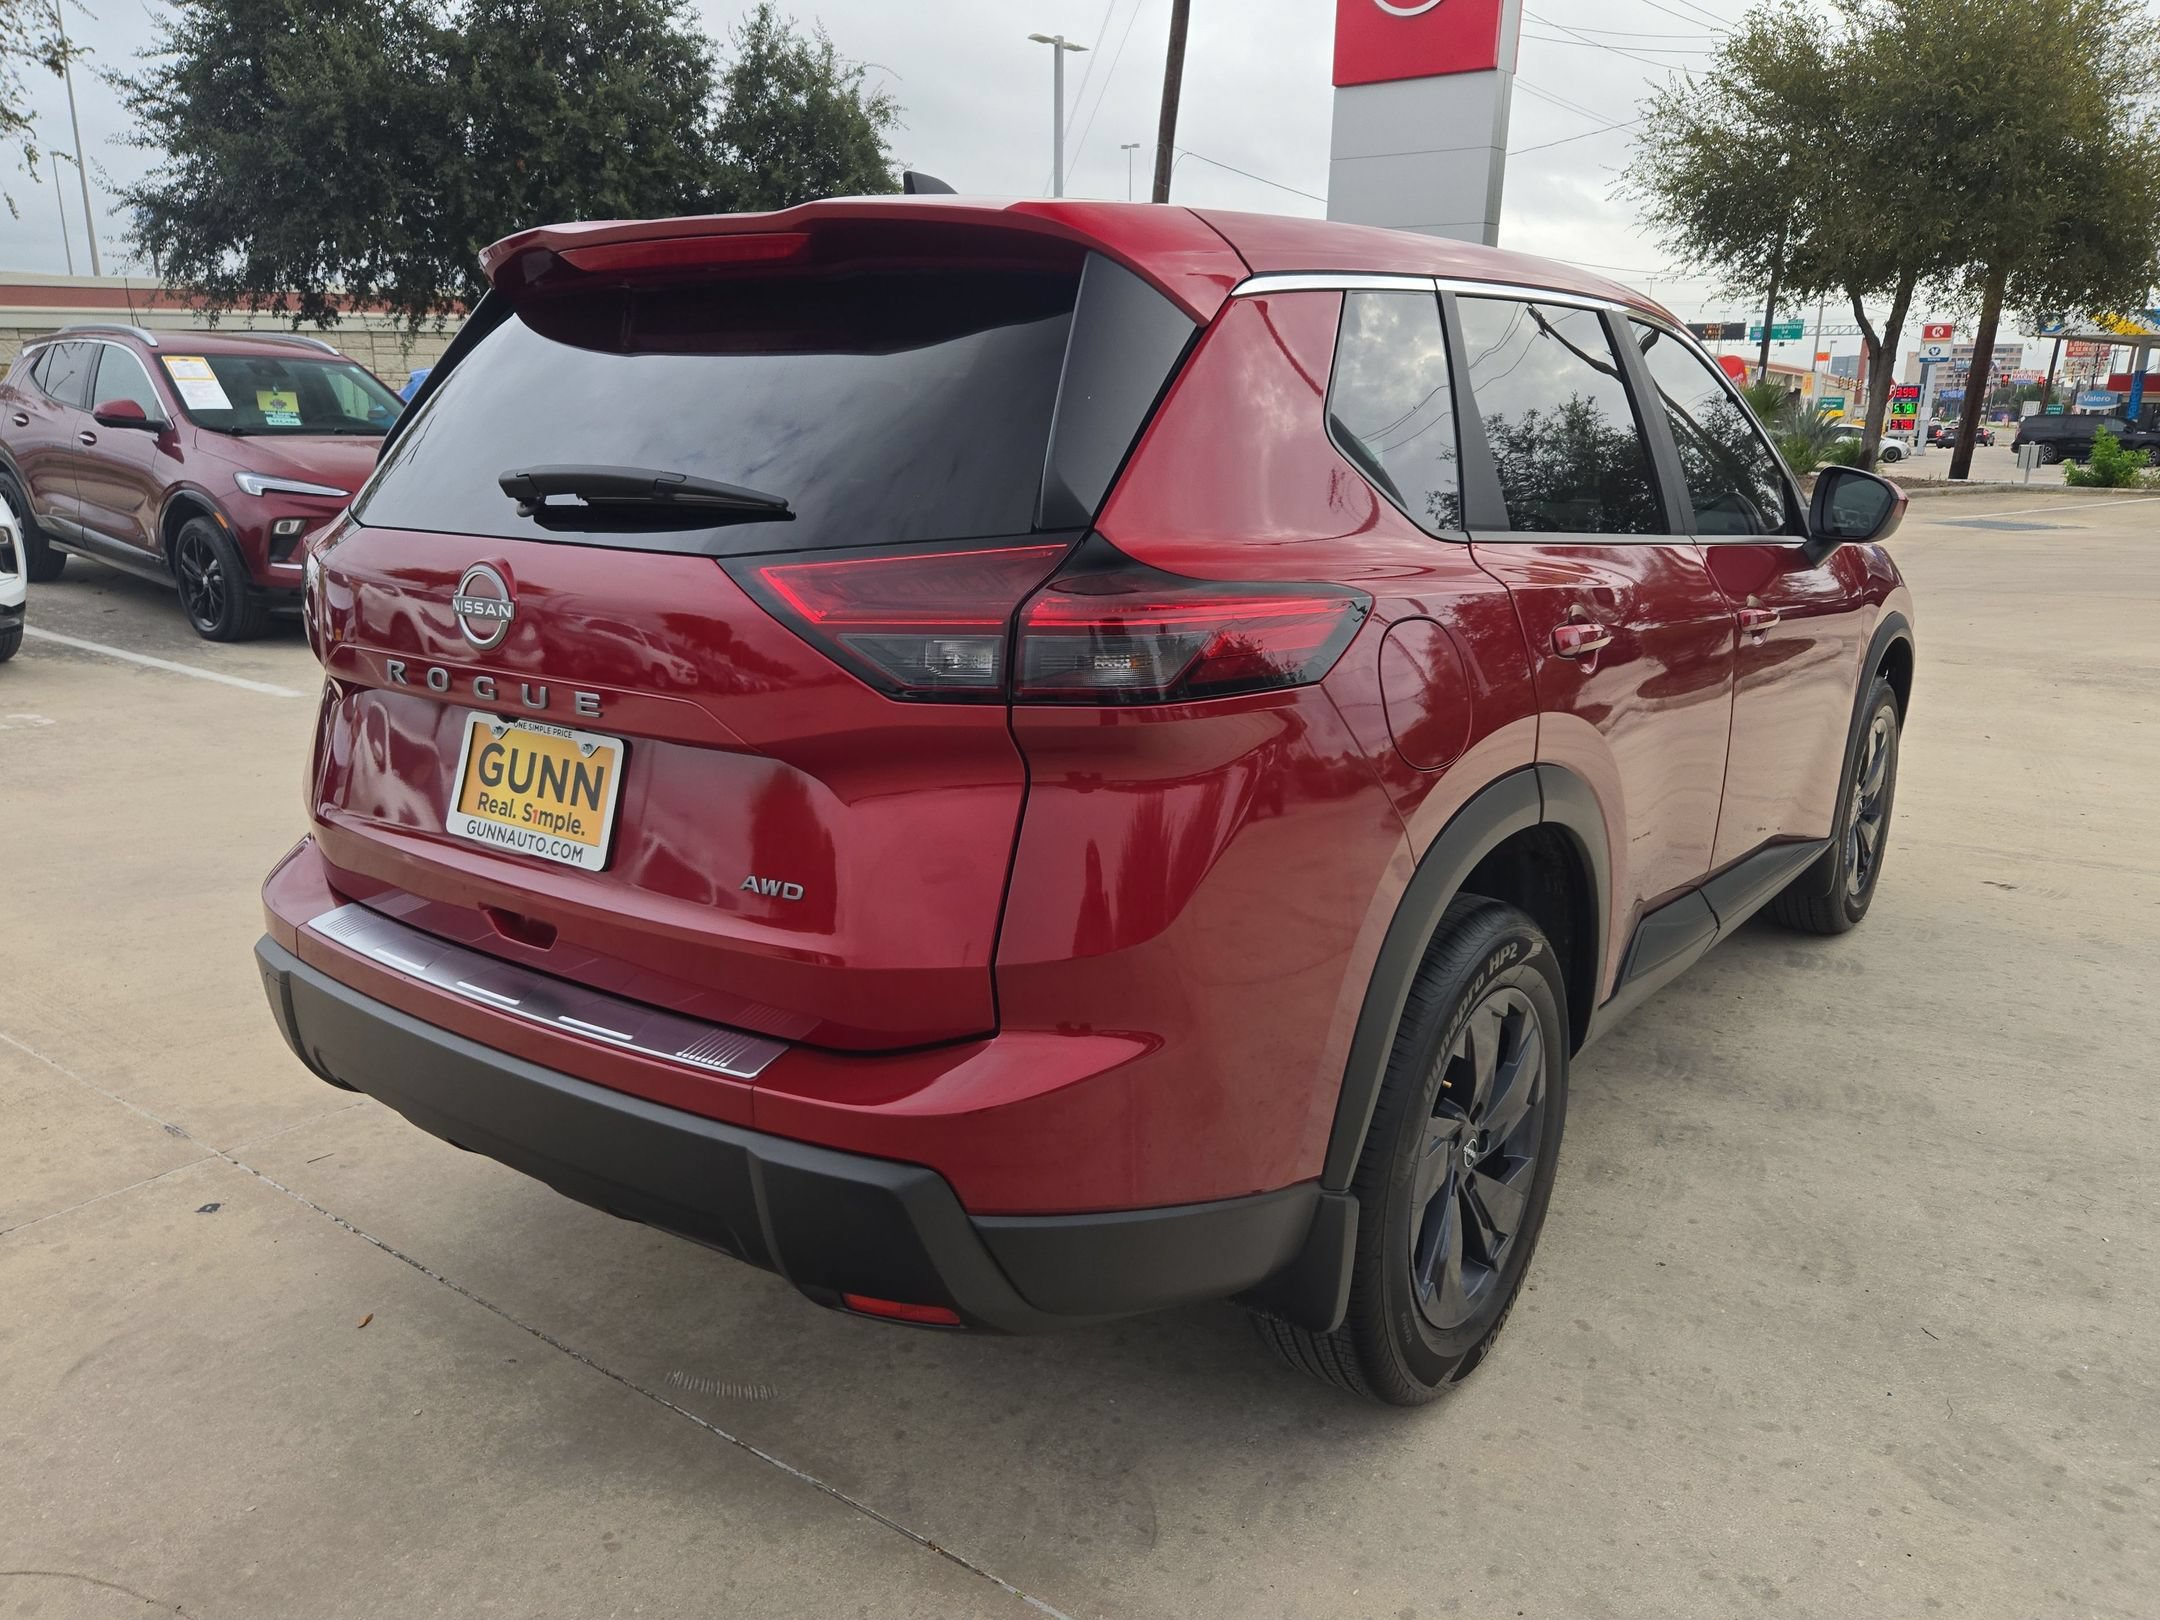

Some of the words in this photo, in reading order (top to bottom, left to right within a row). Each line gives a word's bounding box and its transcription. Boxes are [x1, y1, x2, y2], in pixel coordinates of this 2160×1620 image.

[2083, 394, 2111, 402] Valero
[453, 598, 512, 618] NISSAN
[386, 658, 602, 718] ROGUE
[514, 721, 527, 730] ONE
[528, 723, 552, 735] SIMPLE
[552, 728, 573, 739] PRICE
[478, 742, 605, 812] GUNN
[477, 791, 516, 819] Real.
[466, 819, 584, 863] GUNNAUTO.COM
[740, 875, 804, 900] AWD
[1488, 942, 1519, 976] HP2
